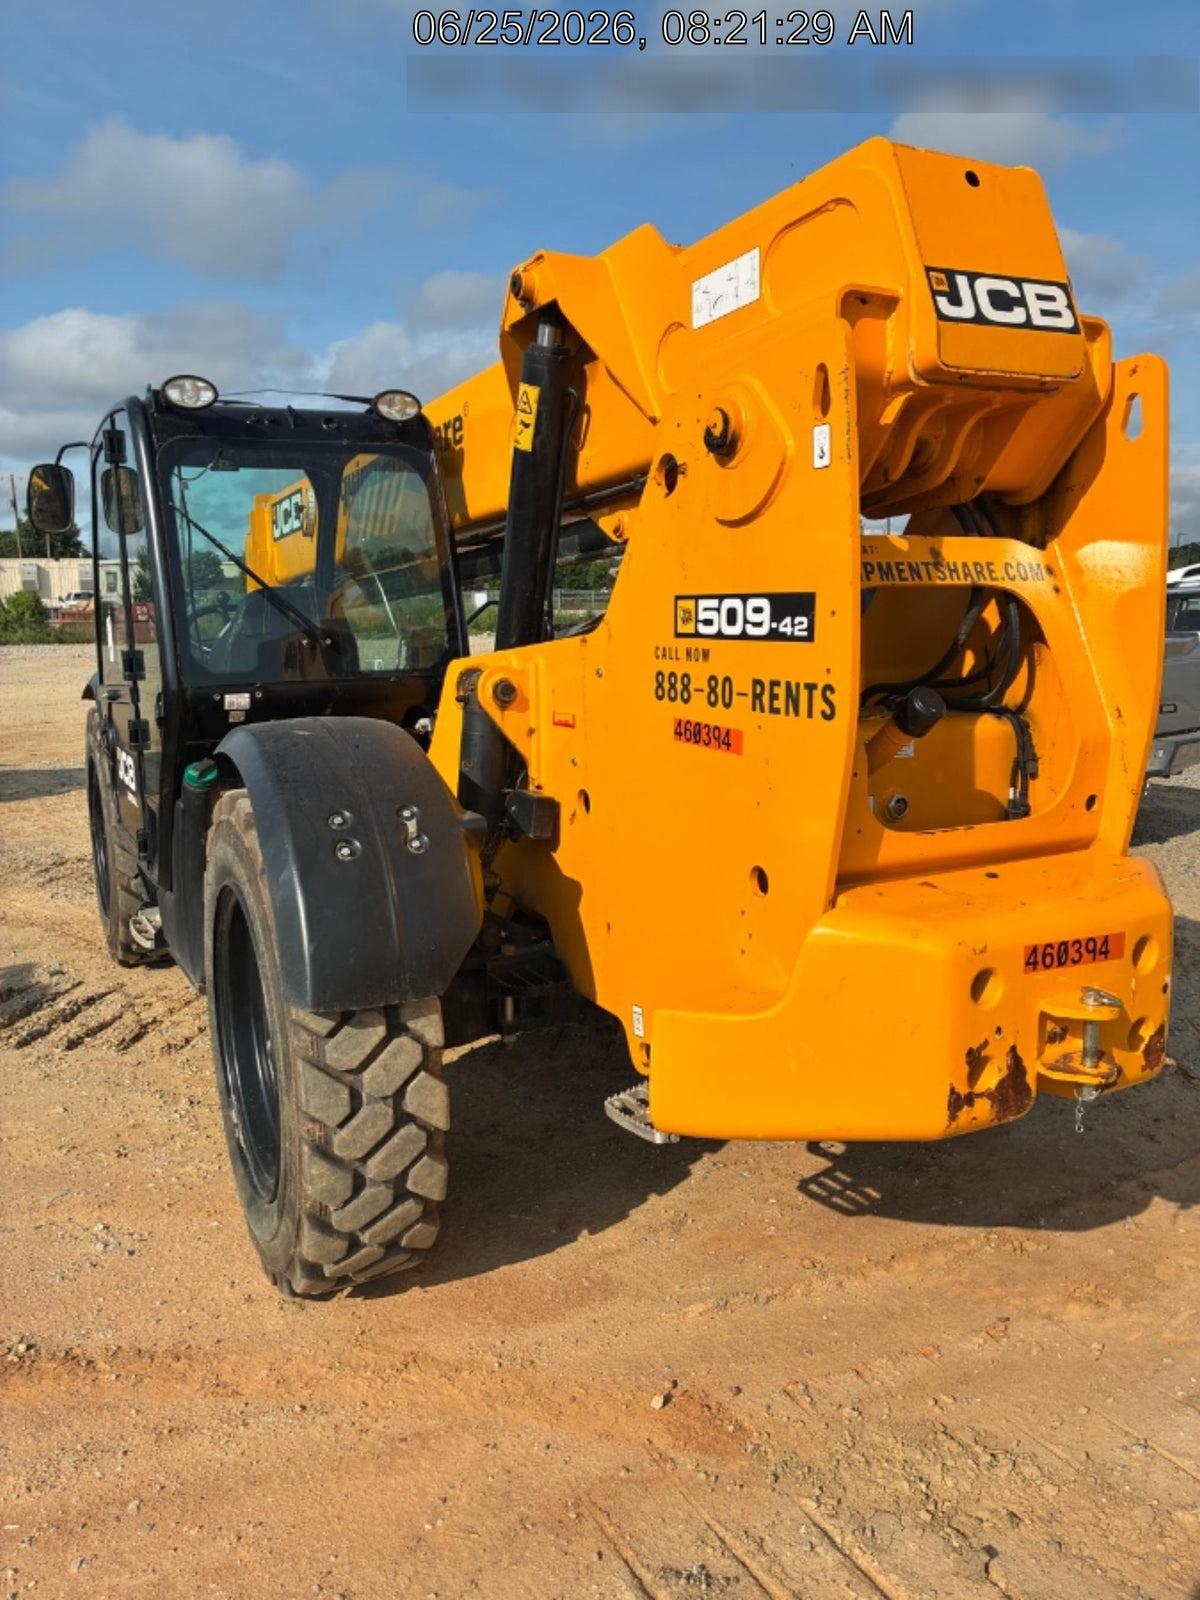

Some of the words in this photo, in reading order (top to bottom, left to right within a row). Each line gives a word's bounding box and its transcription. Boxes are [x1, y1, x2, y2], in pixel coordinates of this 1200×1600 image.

[935, 274, 1075, 330] JCB
[861, 560, 1045, 583] PMENTSHARE.COM
[696, 597, 809, 637] 509-42
[654, 645, 681, 662] CALL
[685, 648, 711, 663] NOW
[654, 670, 837, 722] 888-80-RENTS
[674, 719, 732, 750] 460394
[1025, 935, 1110, 971] 460394
